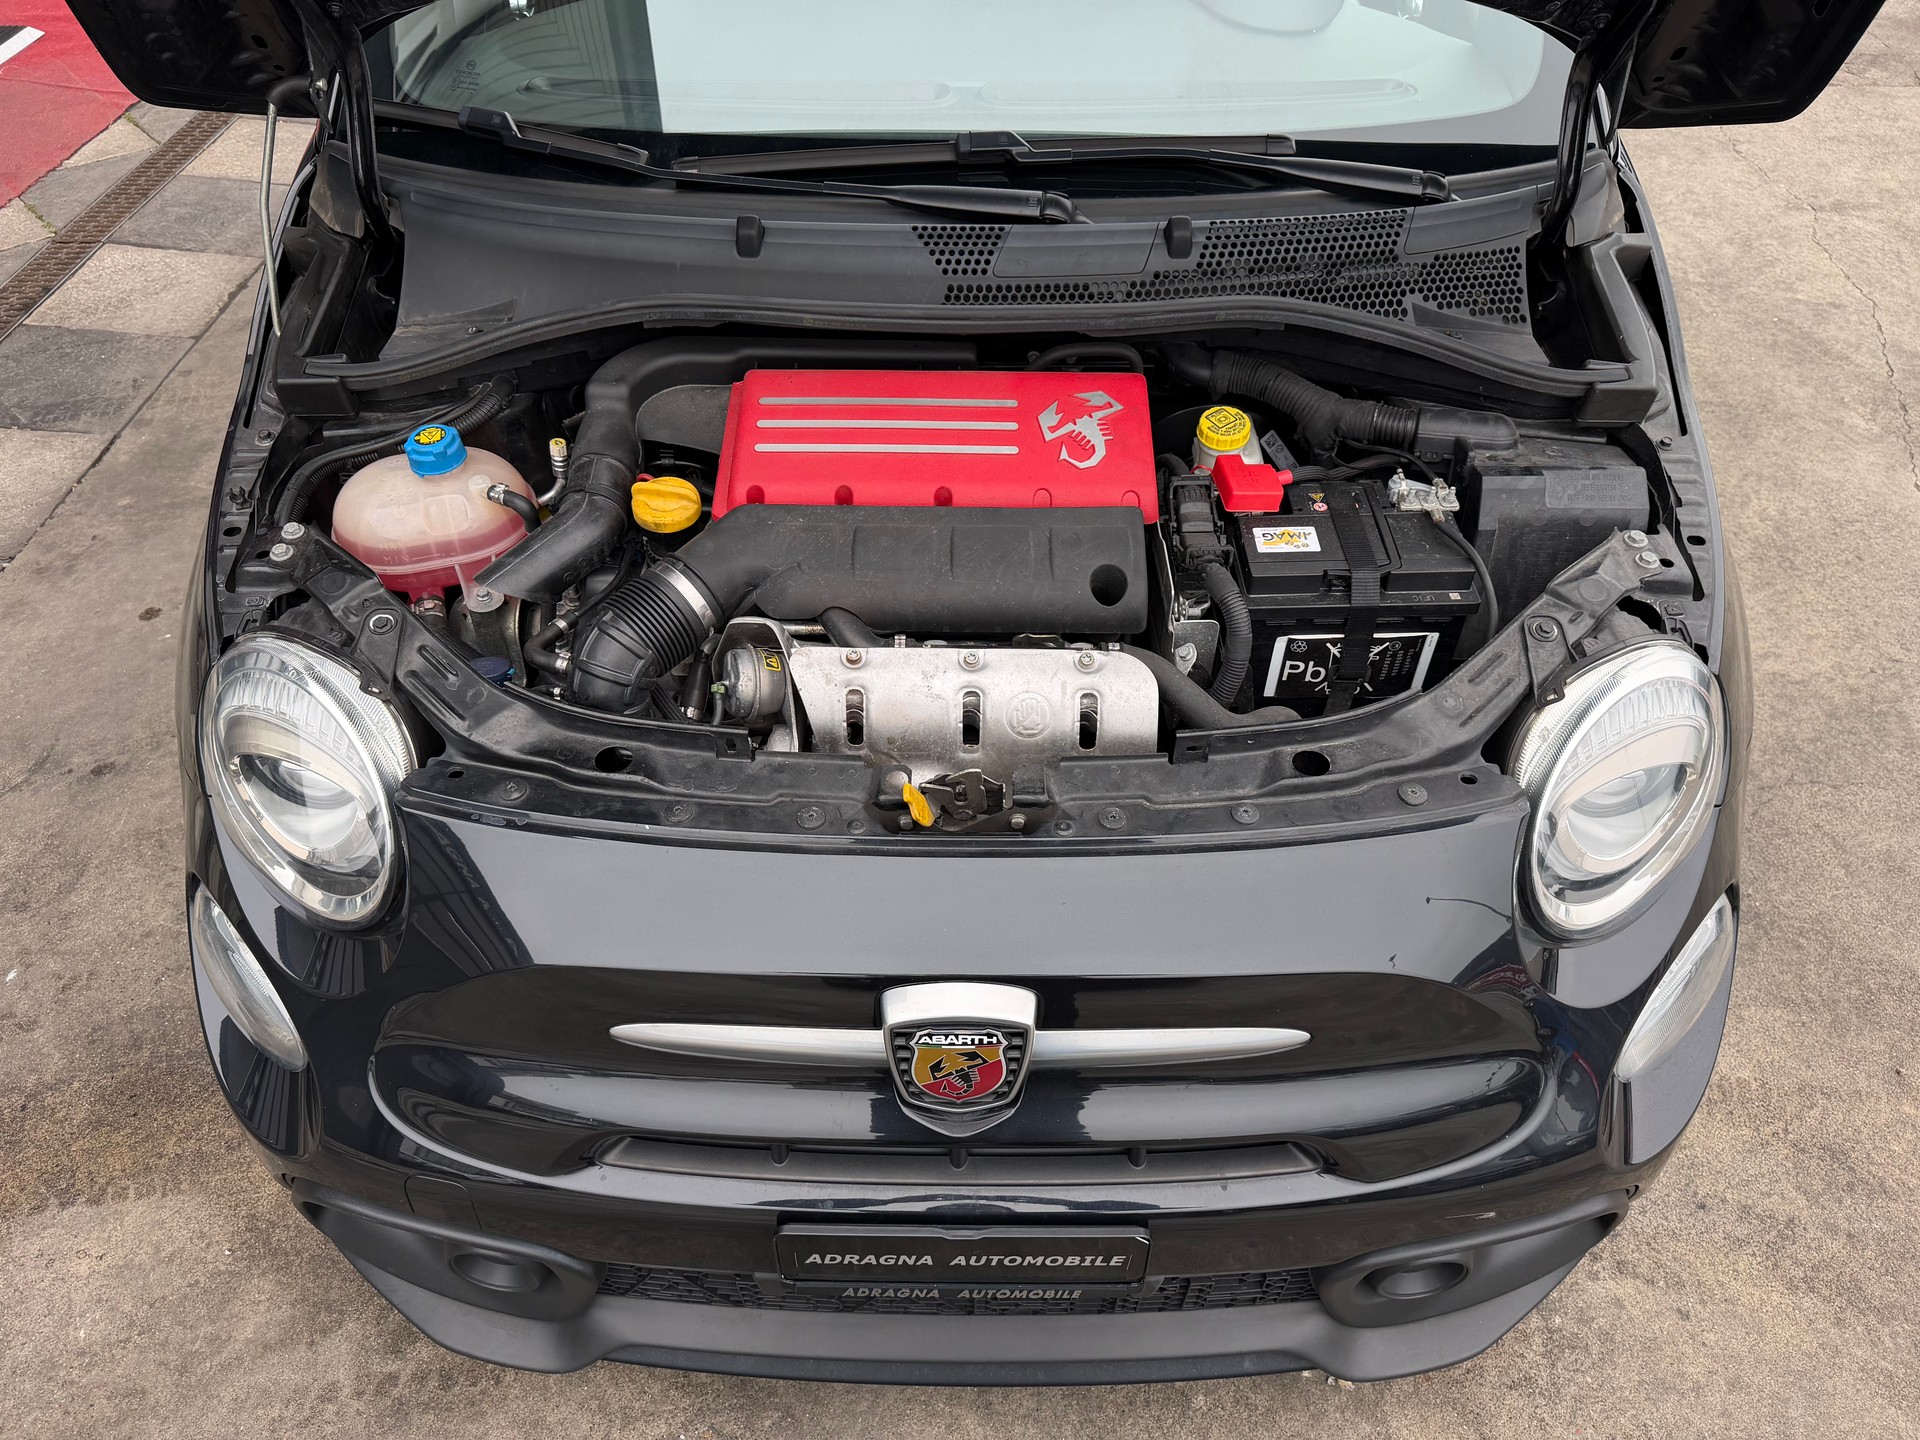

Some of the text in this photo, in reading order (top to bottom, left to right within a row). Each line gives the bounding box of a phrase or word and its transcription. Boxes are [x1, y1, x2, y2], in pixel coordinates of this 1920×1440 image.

[1281, 660, 1327, 683] Pb
[917, 1034, 998, 1045] ABARTH
[804, 1253, 1127, 1266] ADRAGNA AUTOMOBILE
[841, 1287, 1083, 1299] ADRAGNA AUTOMOBILE
